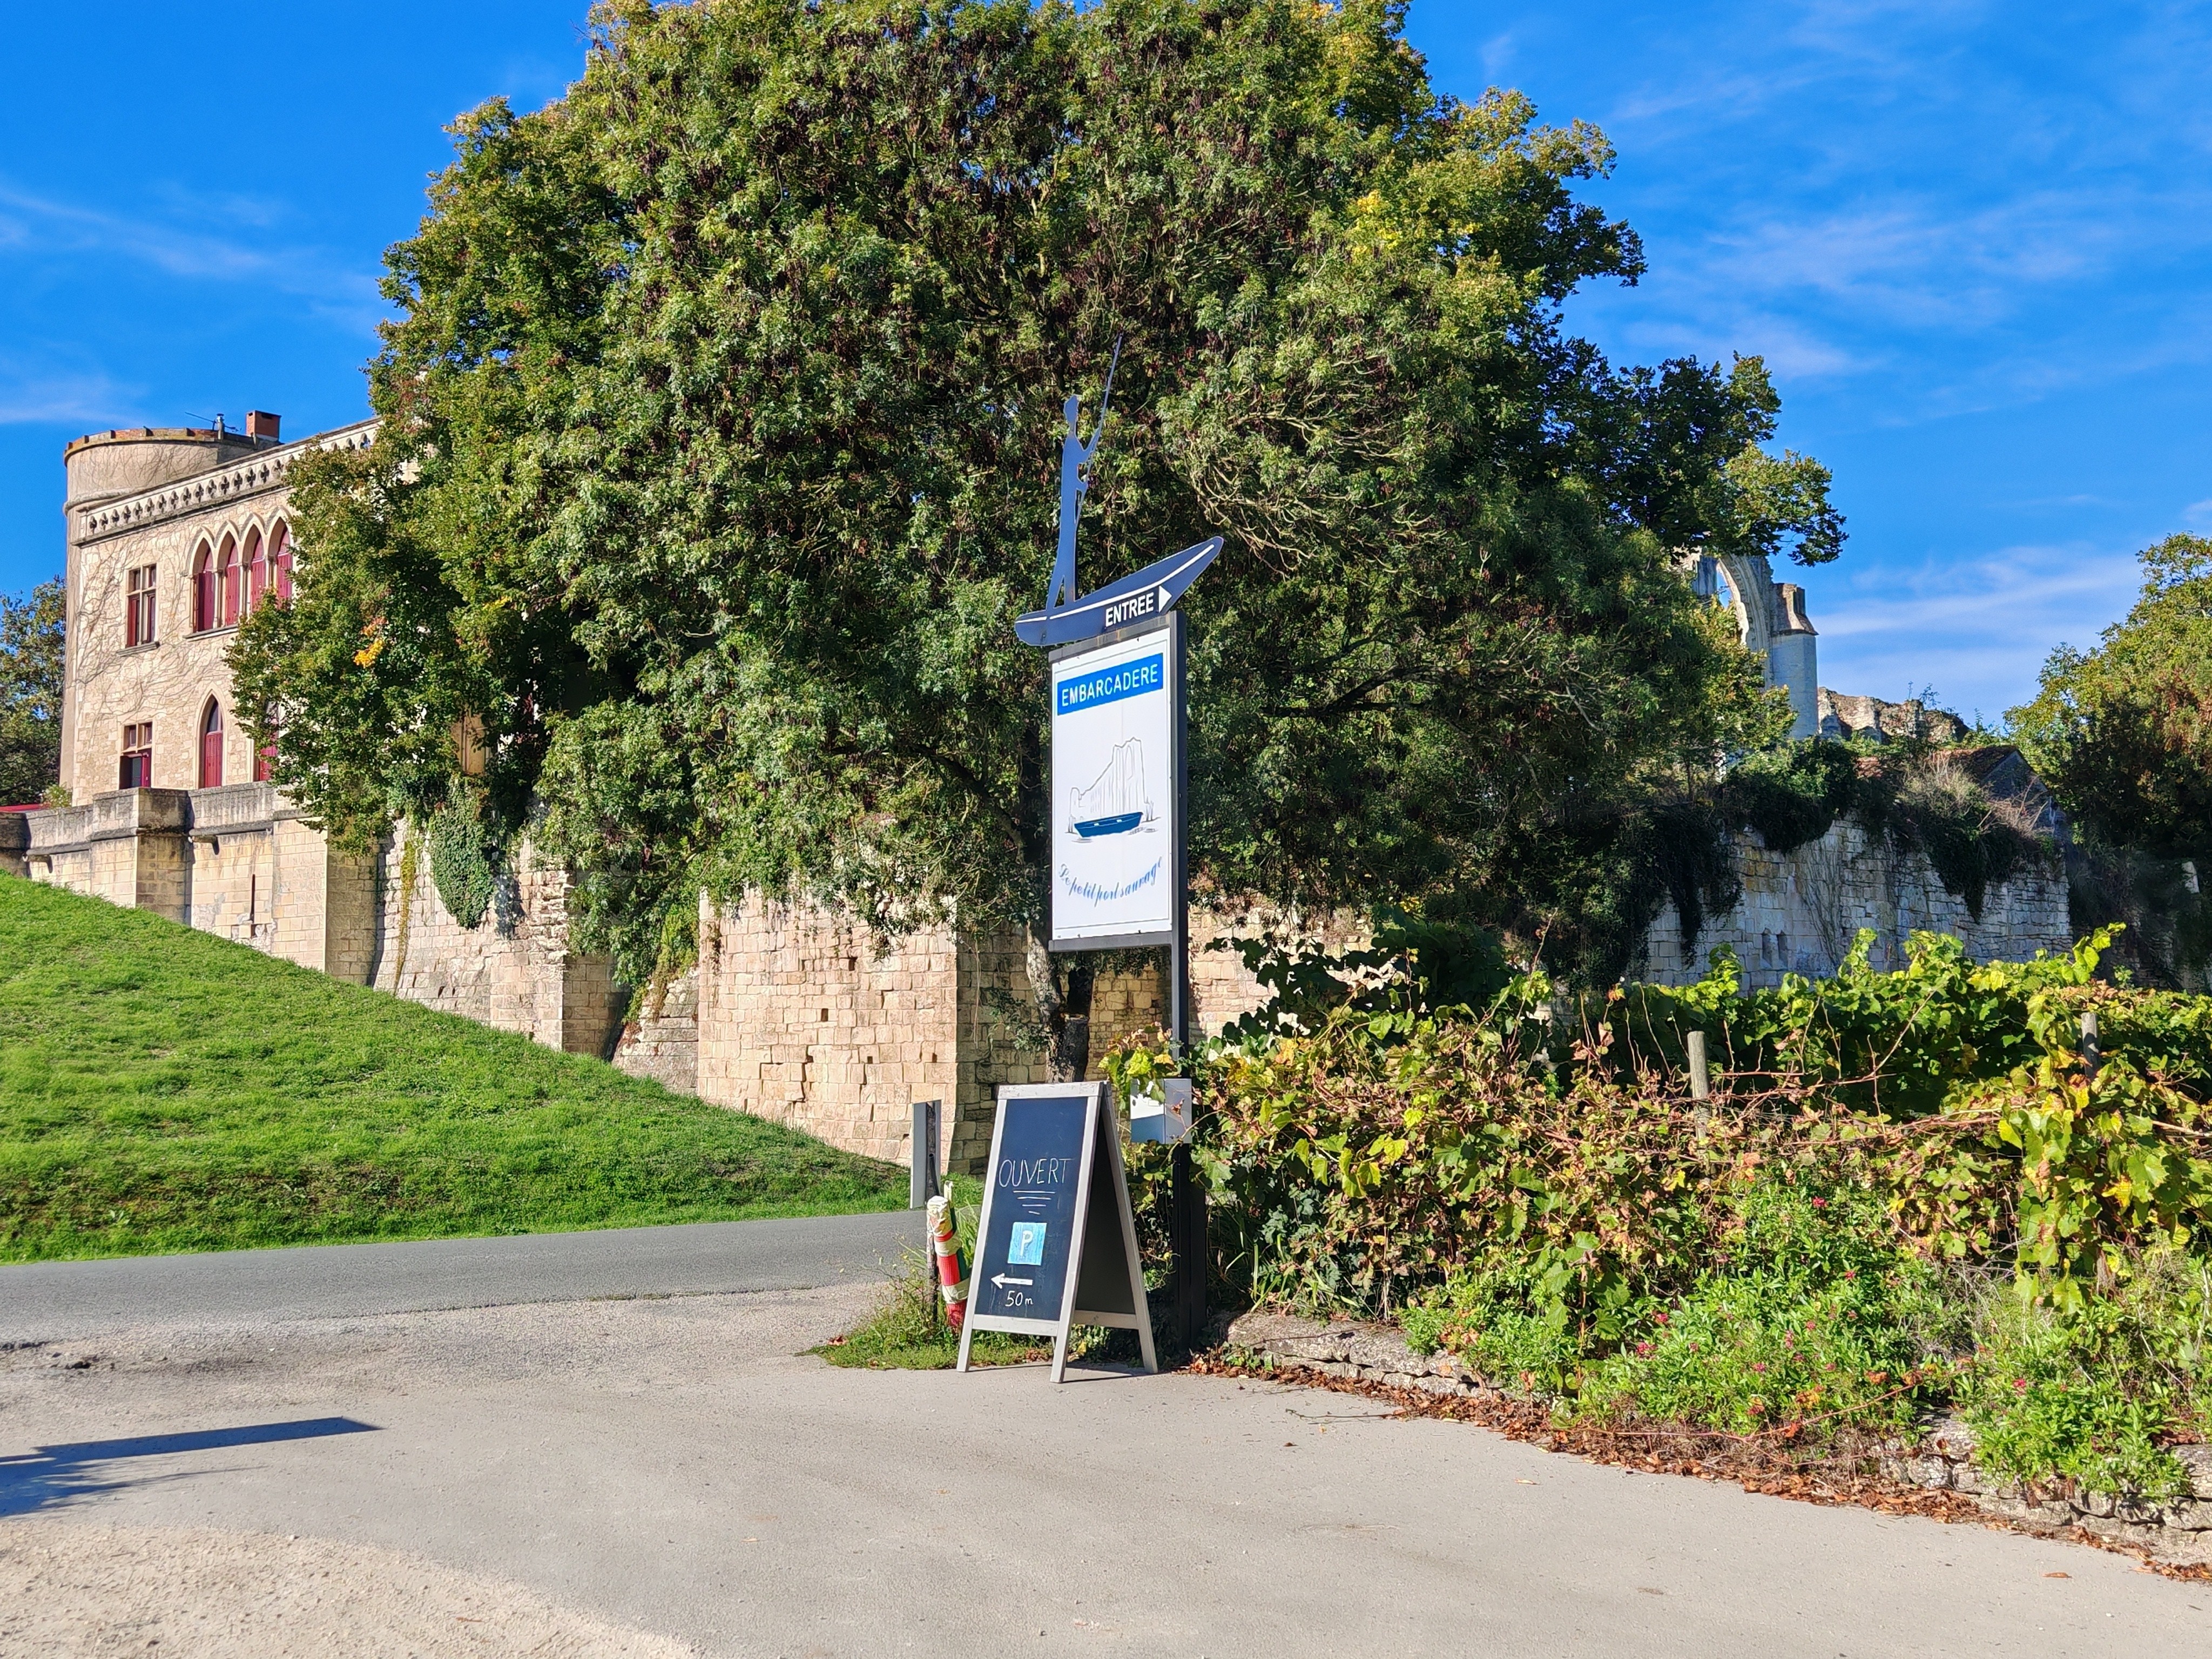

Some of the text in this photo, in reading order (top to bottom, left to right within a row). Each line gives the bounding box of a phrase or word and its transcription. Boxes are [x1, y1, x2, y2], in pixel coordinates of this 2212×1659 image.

[1105, 592, 1154, 628] ENTREE
[1061, 664, 1158, 707] EMBARCADERE
[1094, 882, 1120, 908] port
[1120, 856, 1162, 898] sauvage
[999, 1157, 1075, 1188] OUVERT
[1020, 1230, 1034, 1256] P
